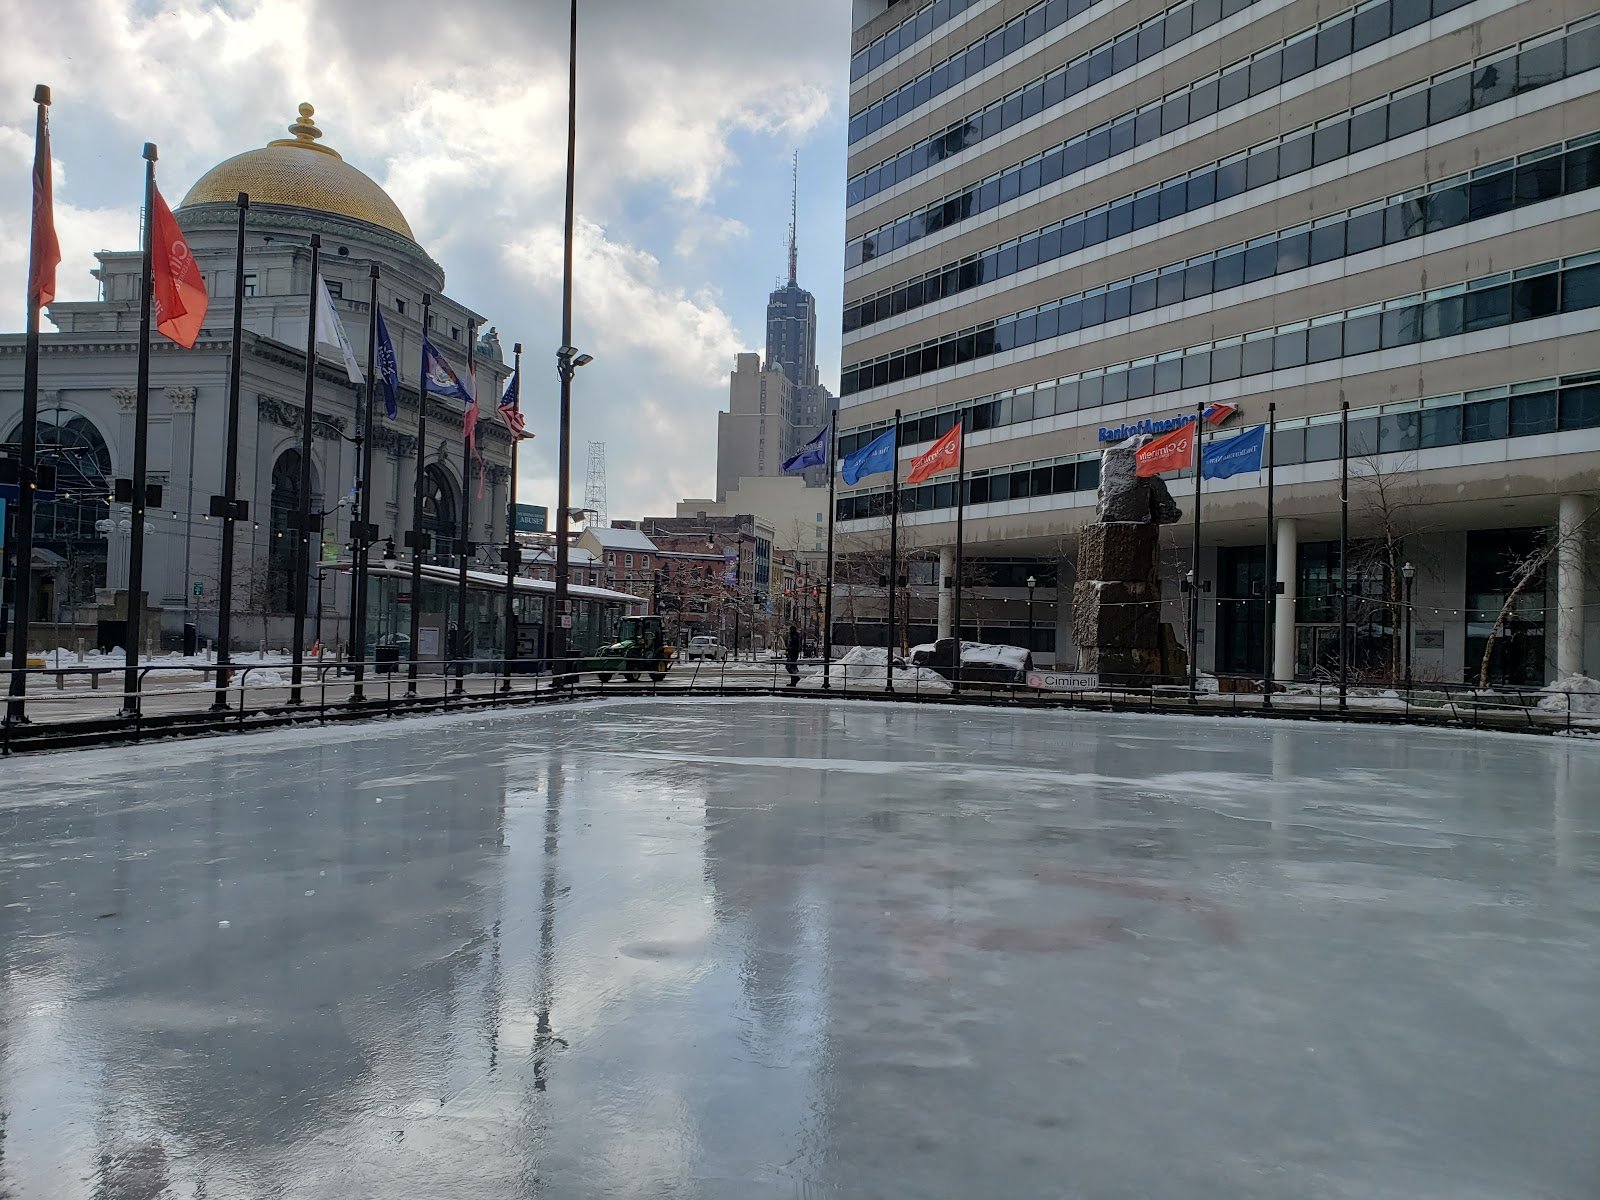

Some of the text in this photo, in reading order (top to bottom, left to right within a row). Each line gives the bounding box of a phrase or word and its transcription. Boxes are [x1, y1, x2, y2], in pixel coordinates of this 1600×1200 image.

[1099, 423, 1129, 441] Bank
[1129, 420, 1143, 435] of
[520, 517, 544, 525] ABUSE?
[1044, 676, 1096, 686] Ciminelli
